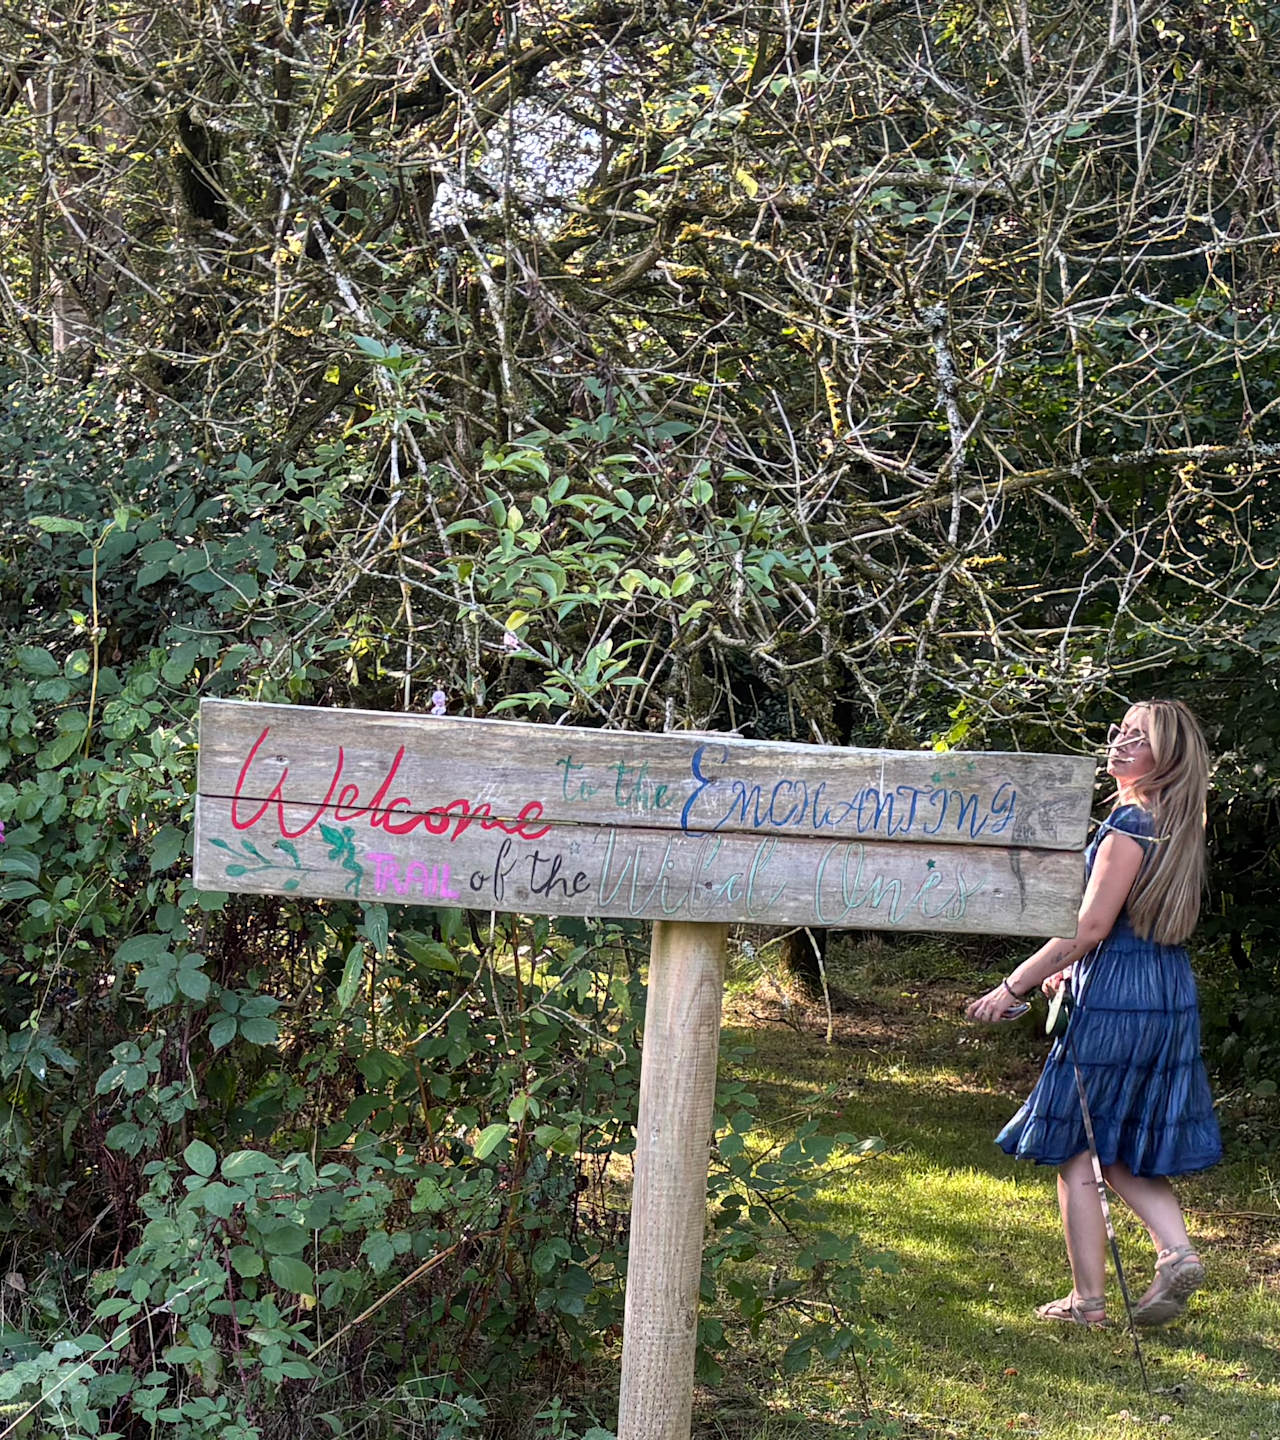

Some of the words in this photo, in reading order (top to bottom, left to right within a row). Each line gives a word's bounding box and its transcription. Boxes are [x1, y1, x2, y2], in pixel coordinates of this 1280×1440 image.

[231, 726, 553, 841] Welcome
[556, 755, 600, 802] to
[608, 758, 672, 810] the
[366, 852, 461, 899] TRAIL
[470, 837, 517, 902] of
[525, 849, 591, 898] the
[593, 820, 788, 918] Wild
[815, 841, 989, 926] Ones
